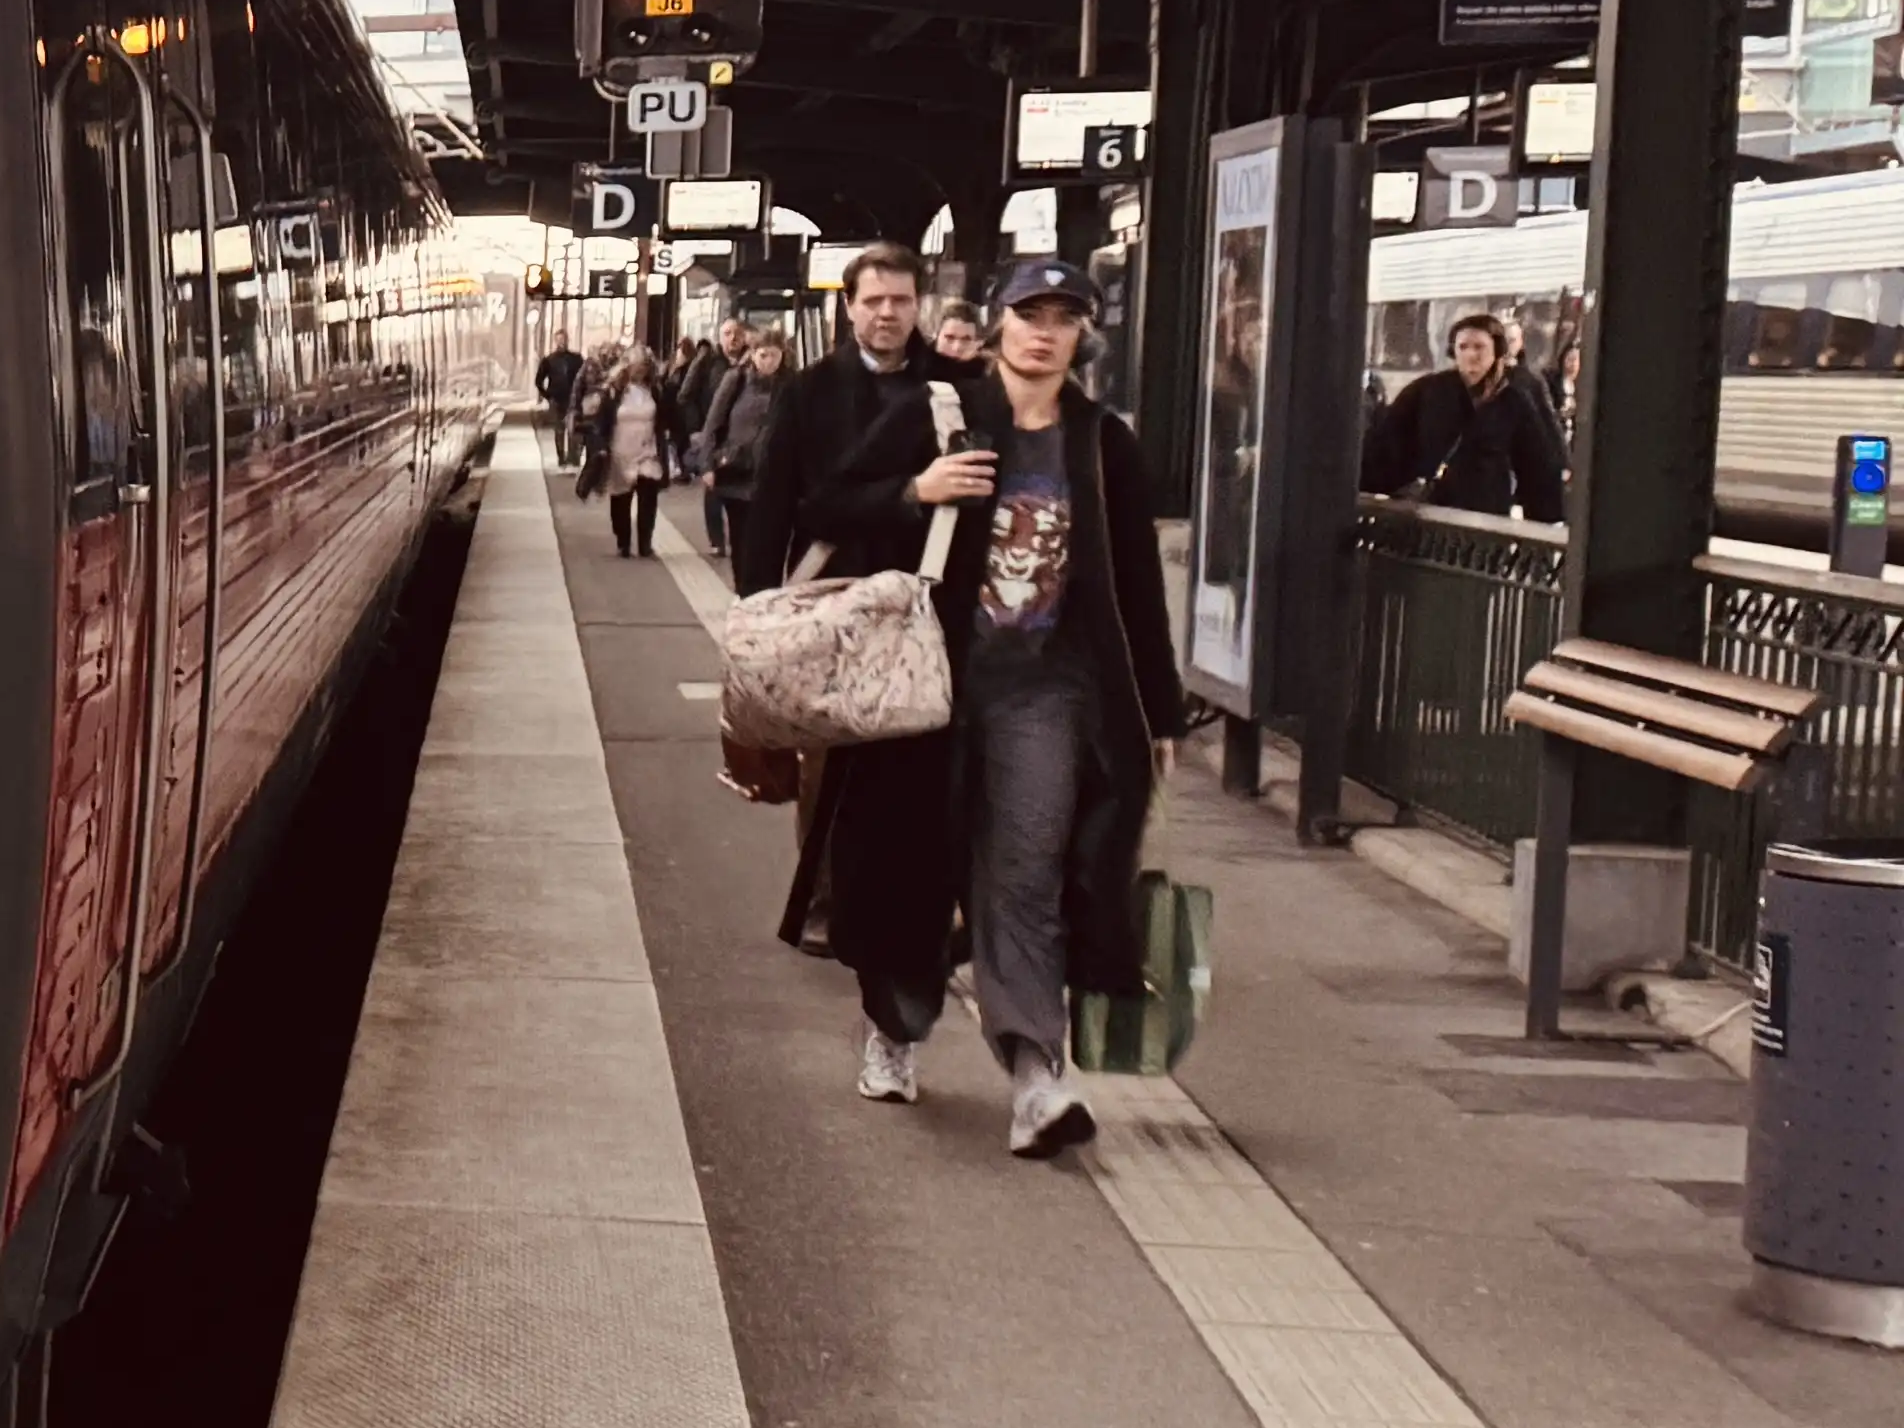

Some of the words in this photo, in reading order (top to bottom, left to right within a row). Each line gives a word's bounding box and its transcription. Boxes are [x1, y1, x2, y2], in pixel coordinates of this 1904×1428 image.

[639, 90, 696, 124] PU
[1097, 138, 1122, 169] 6
[592, 183, 636, 230] D
[1449, 171, 1498, 218] D
[658, 249, 673, 268] S
[598, 275, 614, 296] E
